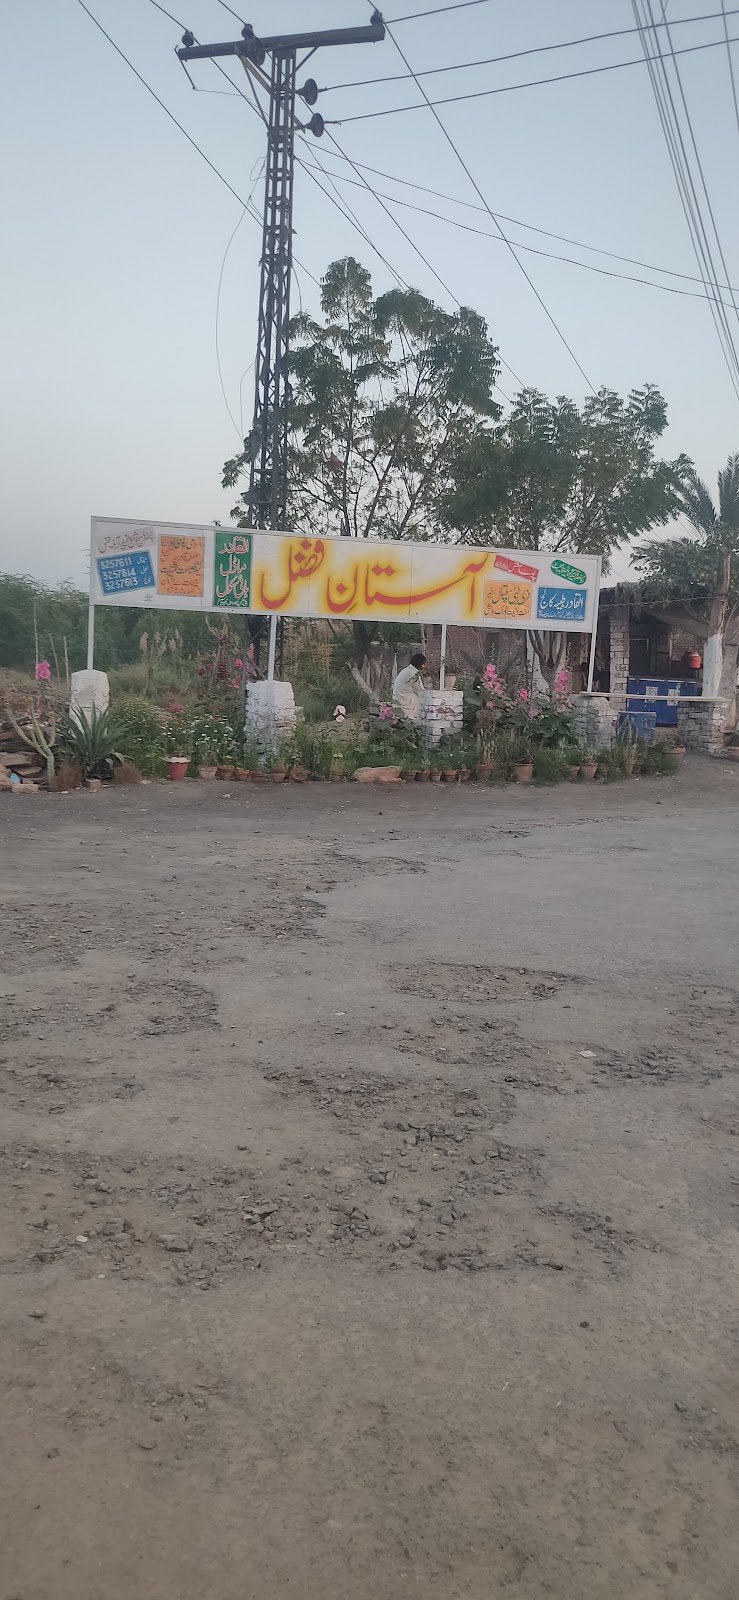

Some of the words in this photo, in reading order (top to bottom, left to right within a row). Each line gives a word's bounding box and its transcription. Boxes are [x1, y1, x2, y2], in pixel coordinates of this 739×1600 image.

[218, 535, 250, 554] القادر
[100, 557, 132, 570] 3257611
[220, 553, 248, 577] ماڈل
[102, 567, 136, 580] 3257614
[260, 538, 325, 610] فضل
[104, 577, 138, 590] 3257613
[216, 575, 240, 598] سکول
[540, 588, 557, 609] کالج
[564, 592, 584, 609] القادر
